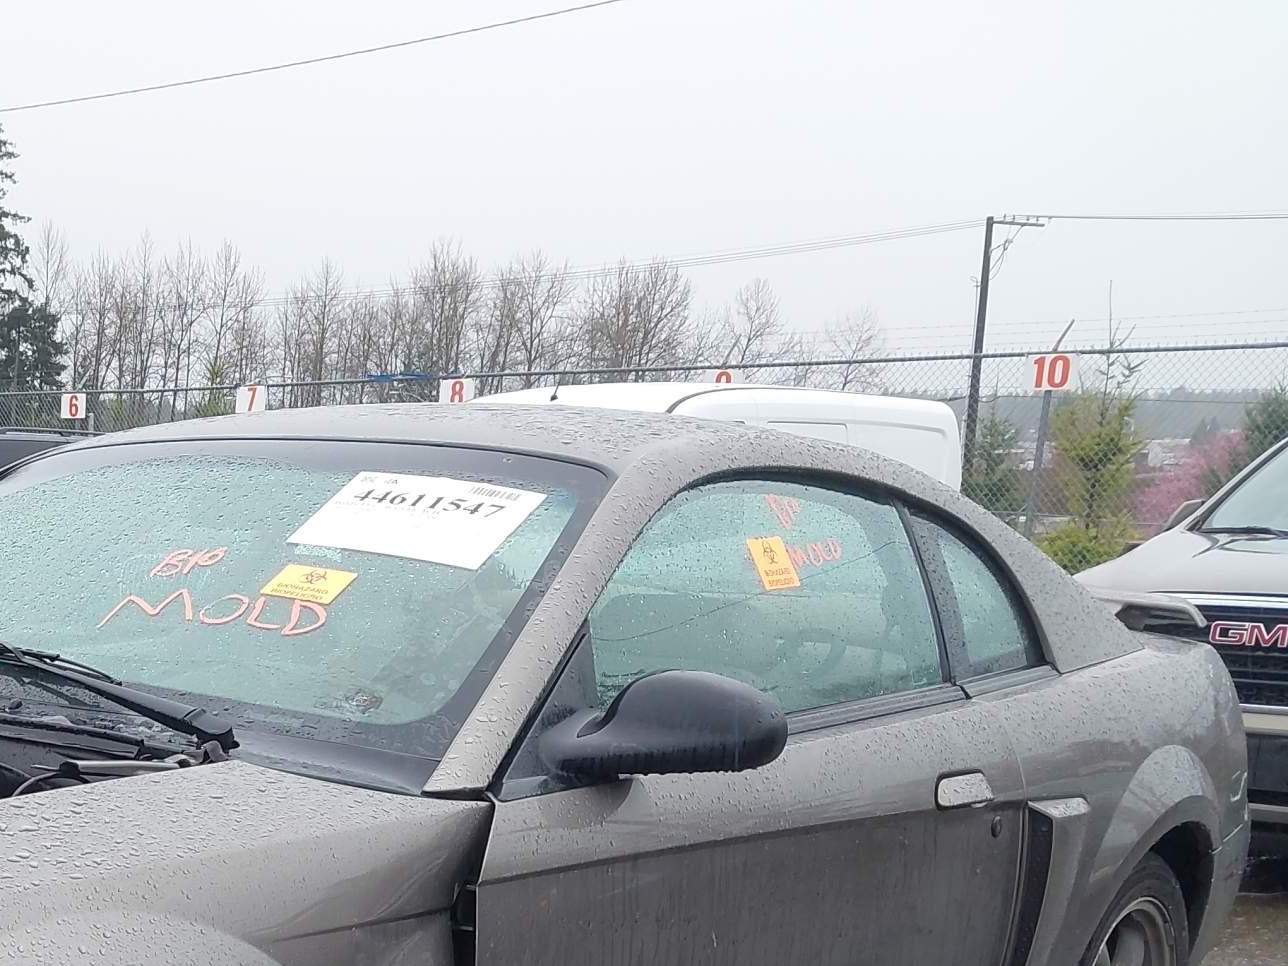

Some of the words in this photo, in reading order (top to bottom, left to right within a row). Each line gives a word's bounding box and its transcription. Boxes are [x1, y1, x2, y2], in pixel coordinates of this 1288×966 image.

[1033, 355, 1072, 390] 10
[247, 387, 258, 411] 7
[450, 380, 465, 403] 8
[69, 395, 79, 417] 6
[353, 488, 507, 518] 44611547
[96, 588, 328, 636] MOLD
